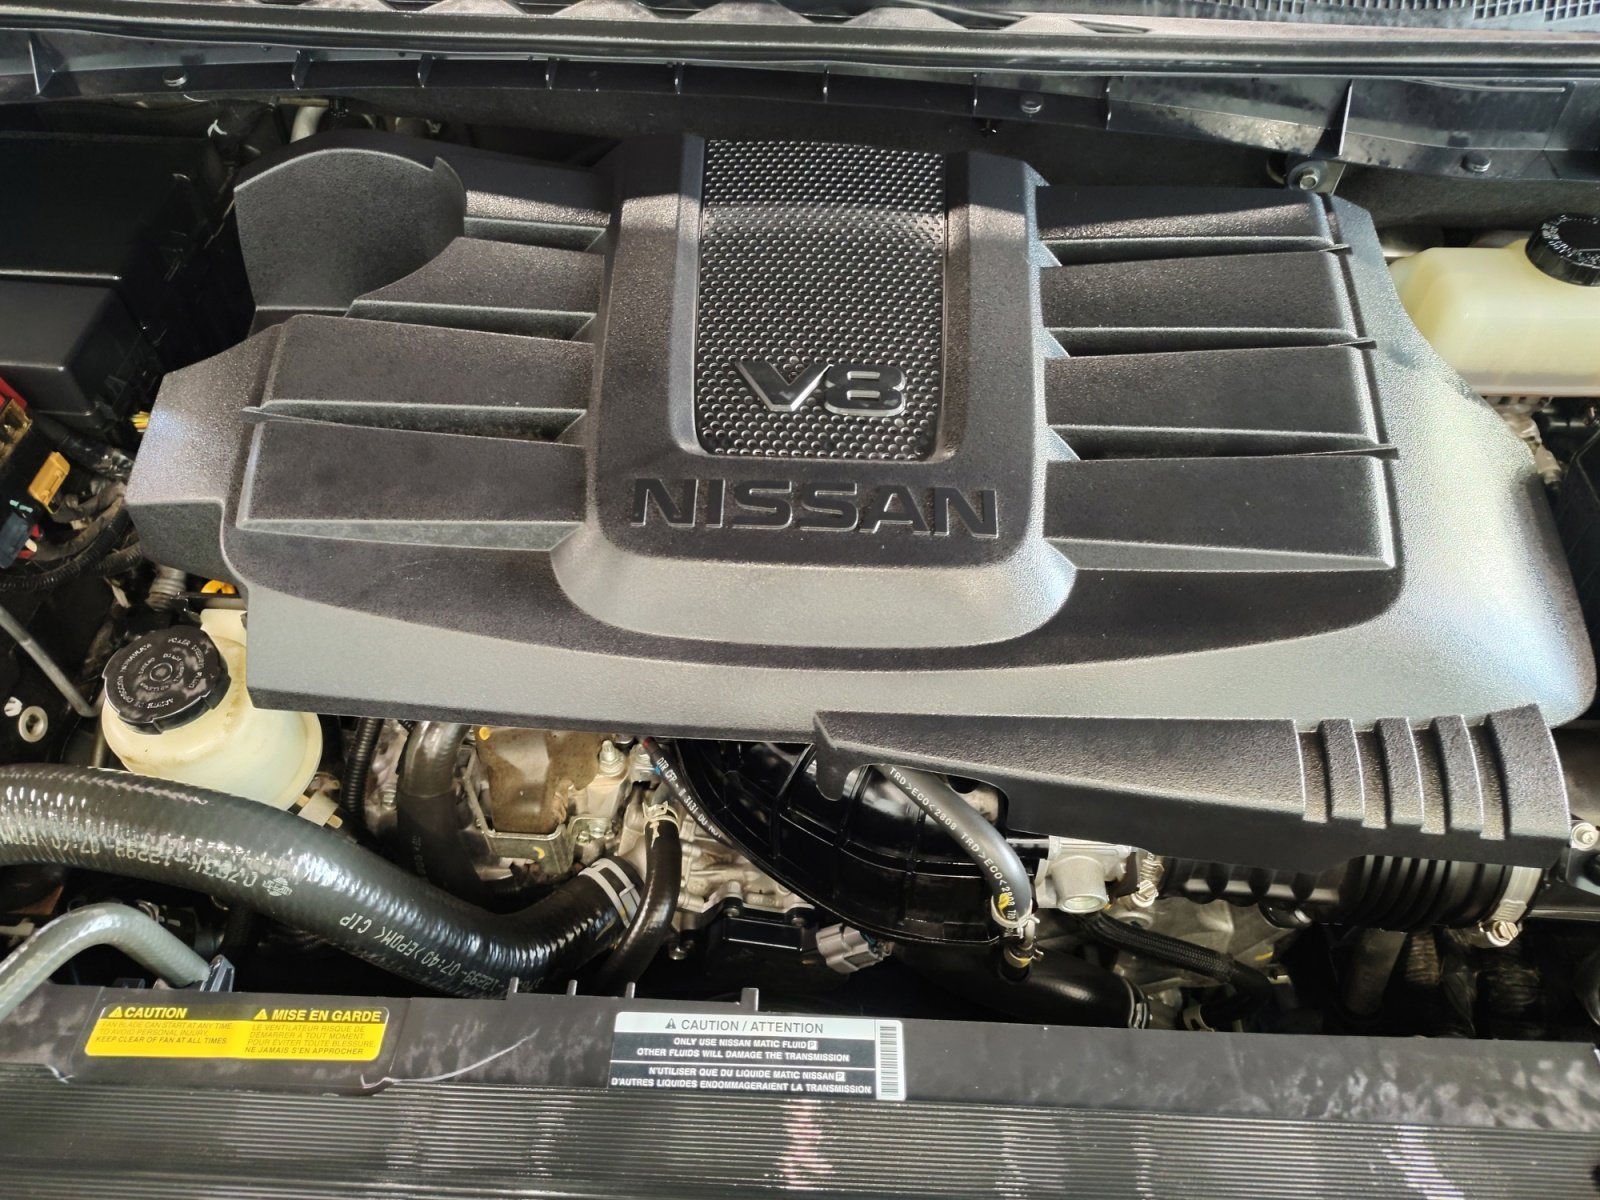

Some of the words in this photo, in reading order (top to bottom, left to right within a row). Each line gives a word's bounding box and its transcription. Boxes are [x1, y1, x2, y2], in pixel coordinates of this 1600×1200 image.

[735, 362, 905, 416] V8
[630, 478, 999, 539] NISSAN
[339, 913, 371, 934] CIP
[124, 1007, 188, 1019] CAUTION
[271, 1009, 306, 1020] MISE
[309, 1010, 329, 1021] EN
[331, 1010, 382, 1022] GARDE
[681, 1019, 739, 1031] CAUTION
[750, 1021, 824, 1034] ATTENTION
[673, 1037, 697, 1046] ONLY
[699, 1038, 717, 1046] USE
[719, 1038, 751, 1047] NISSAN
[753, 1039, 780, 1048] MATIC
[636, 1048, 666, 1056] OTHER
[669, 1048, 700, 1057] FLUIDS
[702, 1049, 723, 1058] WILL
[725, 1050, 763, 1059] DAMAGE
[765, 1051, 783, 1060] THE
[784, 1052, 850, 1062] TRANSMISSION
[648, 1066, 697, 1076] N'UTILISER
[699, 1068, 718, 1077] QUE
[720, 1068, 733, 1077] DU
[735, 1068, 771, 1078] LIQUIDE
[773, 1070, 800, 1079] MATIC
[611, 1078, 654, 1087] D'AUTRES
[656, 1079, 698, 1088] LIQUIDES
[700, 1080, 788, 1091] ENDOMMAGERAIENT
[790, 1083, 803, 1092] LA
